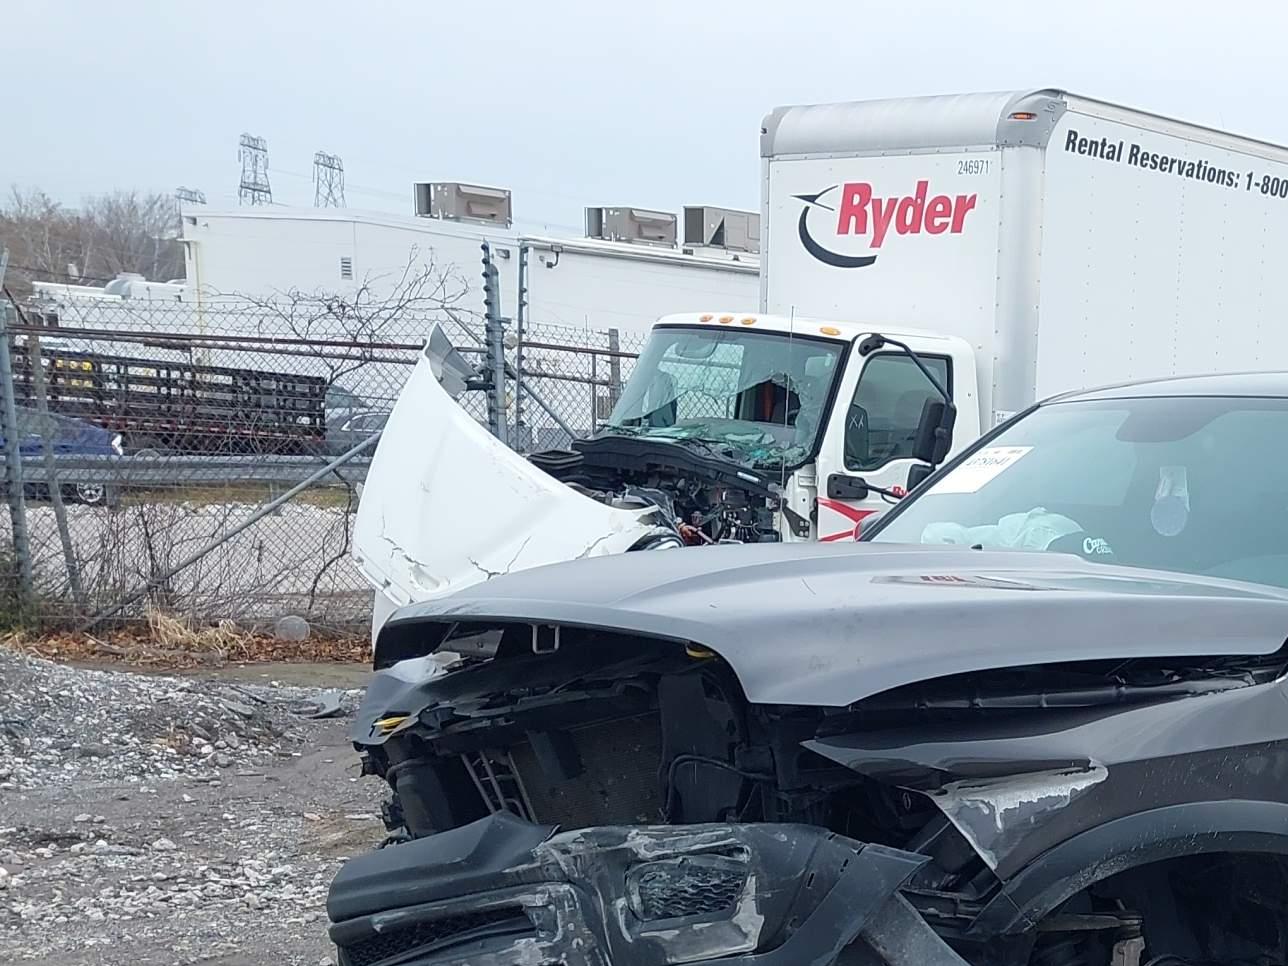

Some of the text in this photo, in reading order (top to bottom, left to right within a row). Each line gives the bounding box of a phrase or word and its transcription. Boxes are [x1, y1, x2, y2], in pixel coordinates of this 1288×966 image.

[958, 159, 989, 175] 246971
[1065, 129, 1124, 162] Rental
[1128, 143, 1241, 188] Reservations:
[837, 180, 977, 248] Ryder
